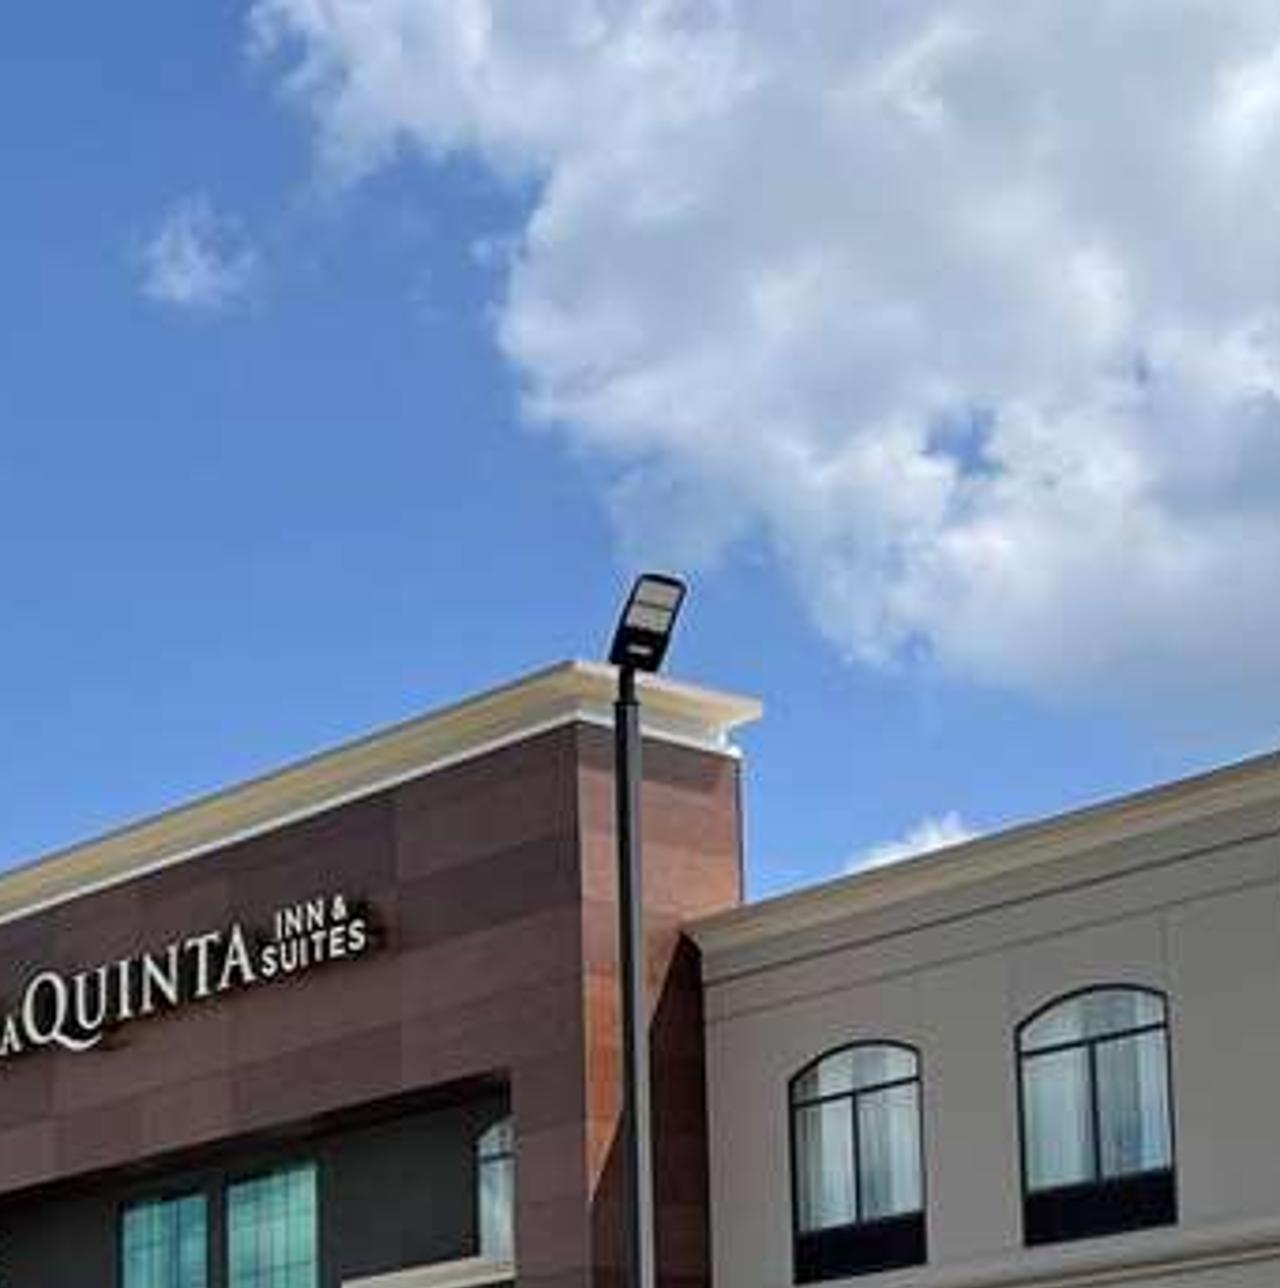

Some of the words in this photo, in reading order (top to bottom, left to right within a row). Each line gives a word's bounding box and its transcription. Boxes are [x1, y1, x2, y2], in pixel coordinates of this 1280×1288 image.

[275, 897, 324, 940] INN
[330, 895, 347, 921] &
[261, 918, 365, 977] SUITES
[23, 922, 257, 1051] QUINTA
